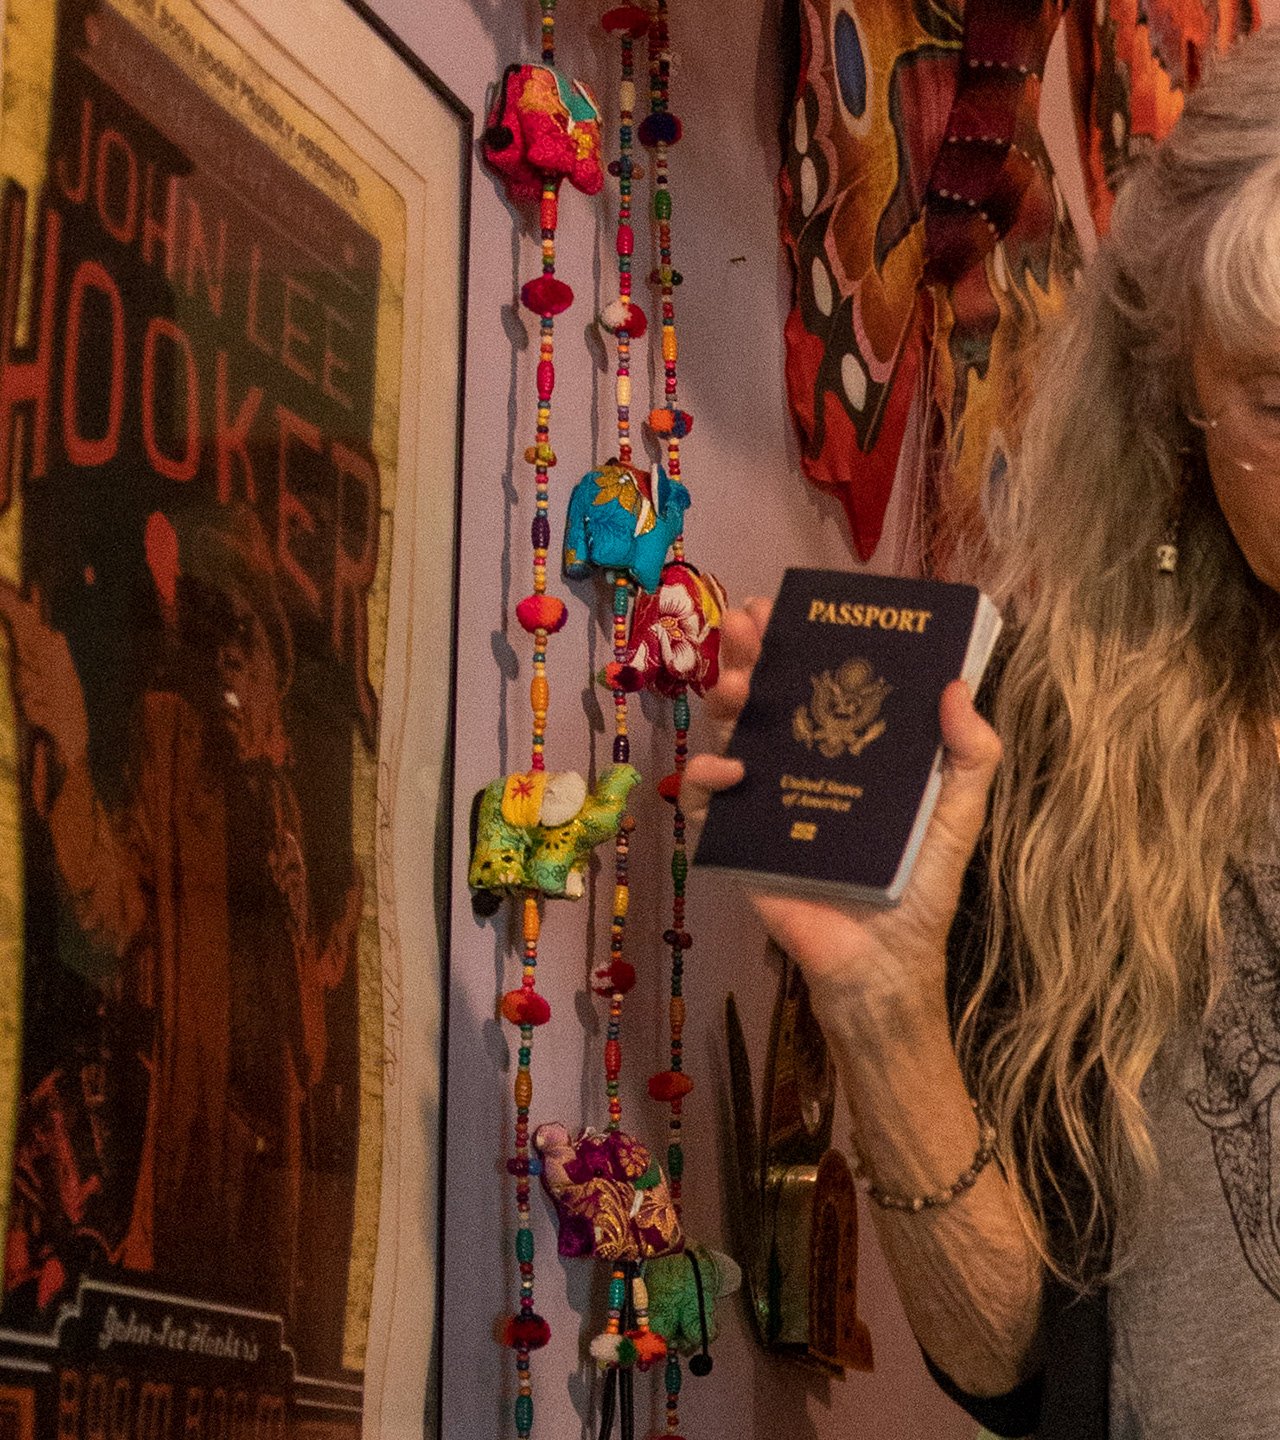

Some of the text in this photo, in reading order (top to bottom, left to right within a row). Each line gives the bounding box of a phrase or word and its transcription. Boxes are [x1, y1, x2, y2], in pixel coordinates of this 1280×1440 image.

[58, 99, 354, 411] JOHN LEE
[0, 190, 382, 700] HOOKER
[807, 599, 932, 634] PASSPORT
